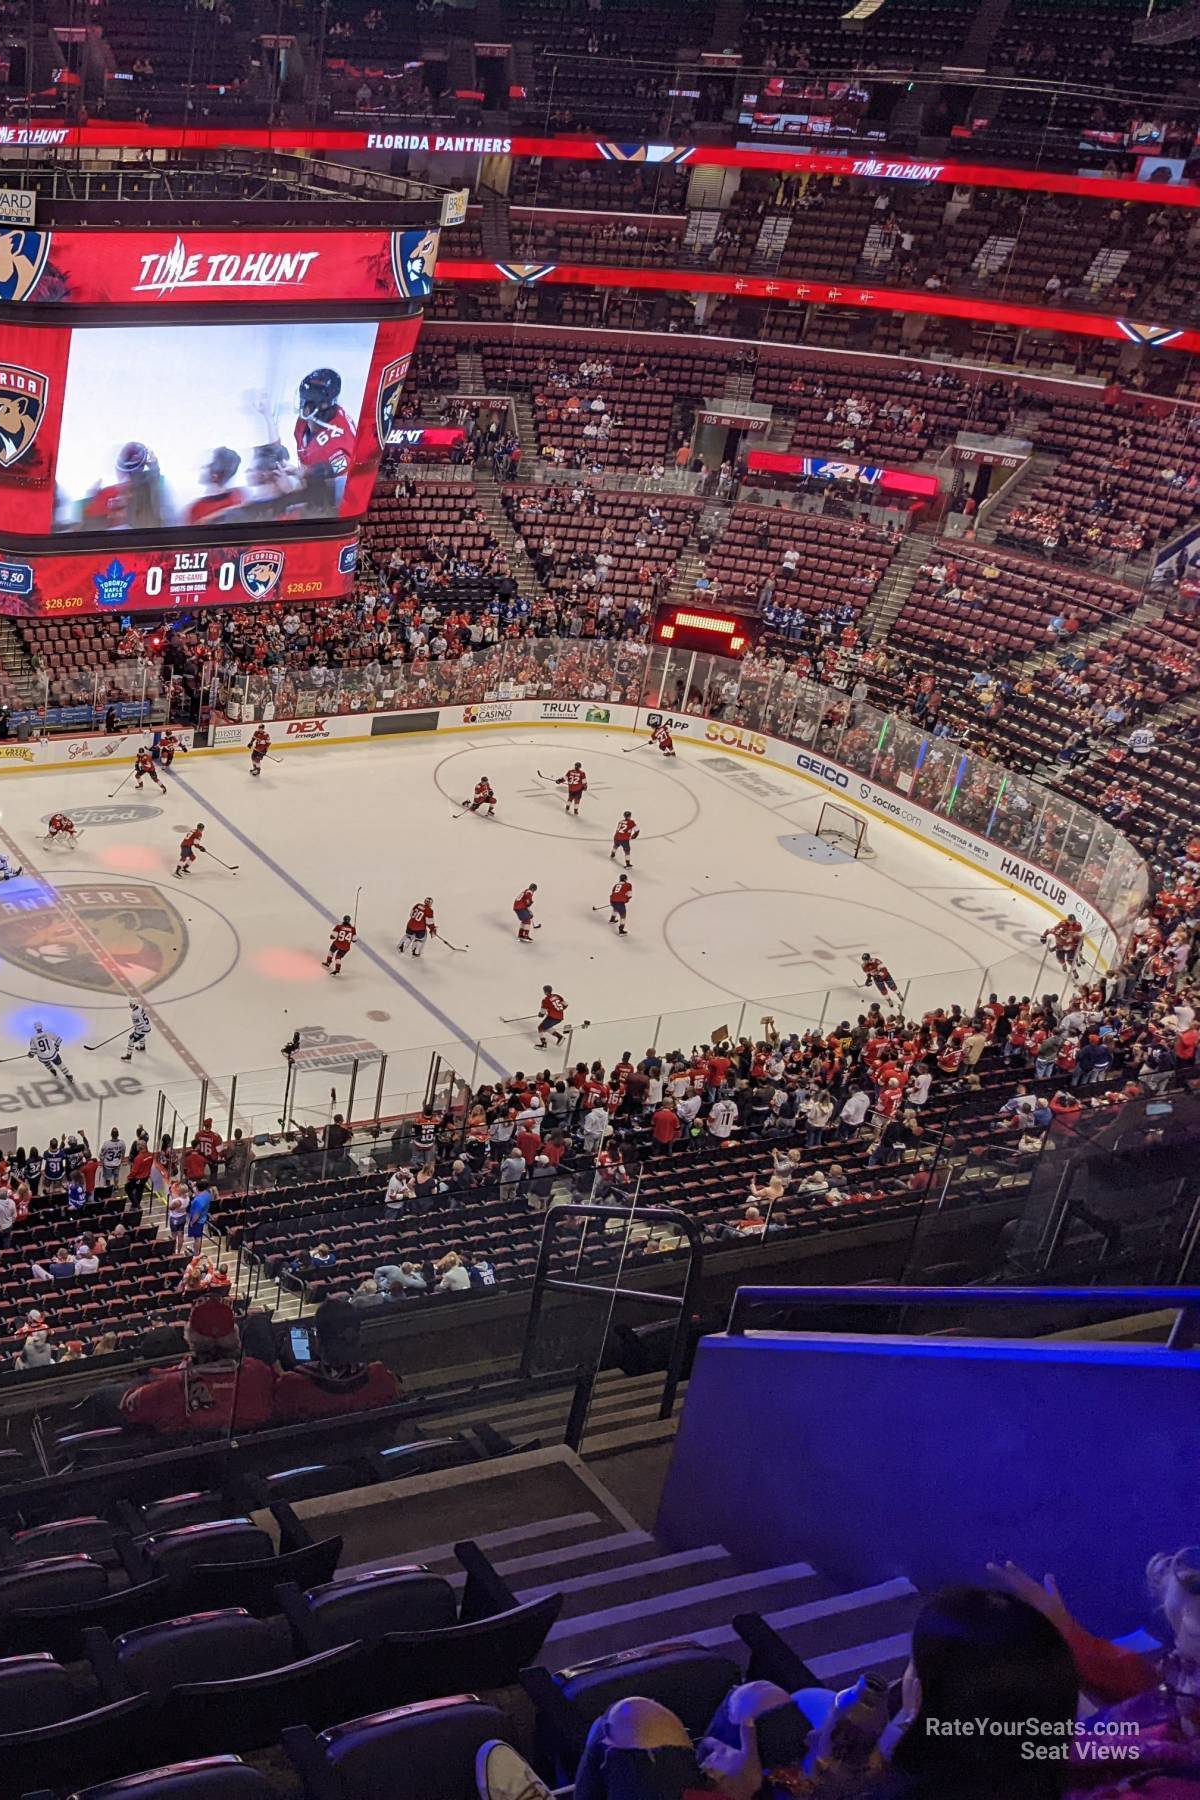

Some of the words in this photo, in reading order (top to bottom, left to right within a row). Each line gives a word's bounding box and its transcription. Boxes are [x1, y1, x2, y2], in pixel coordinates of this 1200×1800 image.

[17, 129, 35, 144] TO
[33, 127, 69, 144] HUNT
[367, 134, 429, 150] FLORIDA
[435, 137, 512, 153] PANTHERS
[851, 160, 884, 176] TIME
[886, 164, 905, 178] TO
[903, 165, 944, 181] HUNT
[208, 255, 243, 283] TO
[243, 251, 320, 284] HUNT
[703, 416, 717, 424] 105
[749, 421, 763, 430] 107
[960, 451, 976, 461] 107
[1000, 458, 1016, 468] 108
[174, 553, 209, 570] 15:17
[246, 551, 279, 562] FLORIDA
[10, 572, 24, 583] 50
[145, 566, 163, 596] 0
[174, 574, 204, 582] PRE-GAME
[218, 562, 236, 591] 0
[100, 579, 128, 589] TORONTO
[287, 582, 322, 596] $28,670
[45, 598, 83, 611] $28,670
[479, 703, 512, 711] SEMINOLE
[542, 703, 580, 713] TRULY
[478, 710, 512, 719] CASINO
[286, 720, 329, 734] DEX
[295, 731, 330, 740] imaging
[704, 723, 768, 755] SOLIS
[796, 754, 849, 789] GEICO
[568, 775, 580, 785] 32
[69, 807, 139, 825] Ford
[1000, 857, 1068, 906] HAIRCLUB
[412, 911, 424, 922] 30
[1075, 902, 1097, 925] CITY
[337, 931, 353, 943] 94
[37, 1039, 50, 1052] 91
[720, 1112, 734, 1126] 11
[106, 1151, 122, 1162] 34
[49, 1162, 61, 1173] 91
